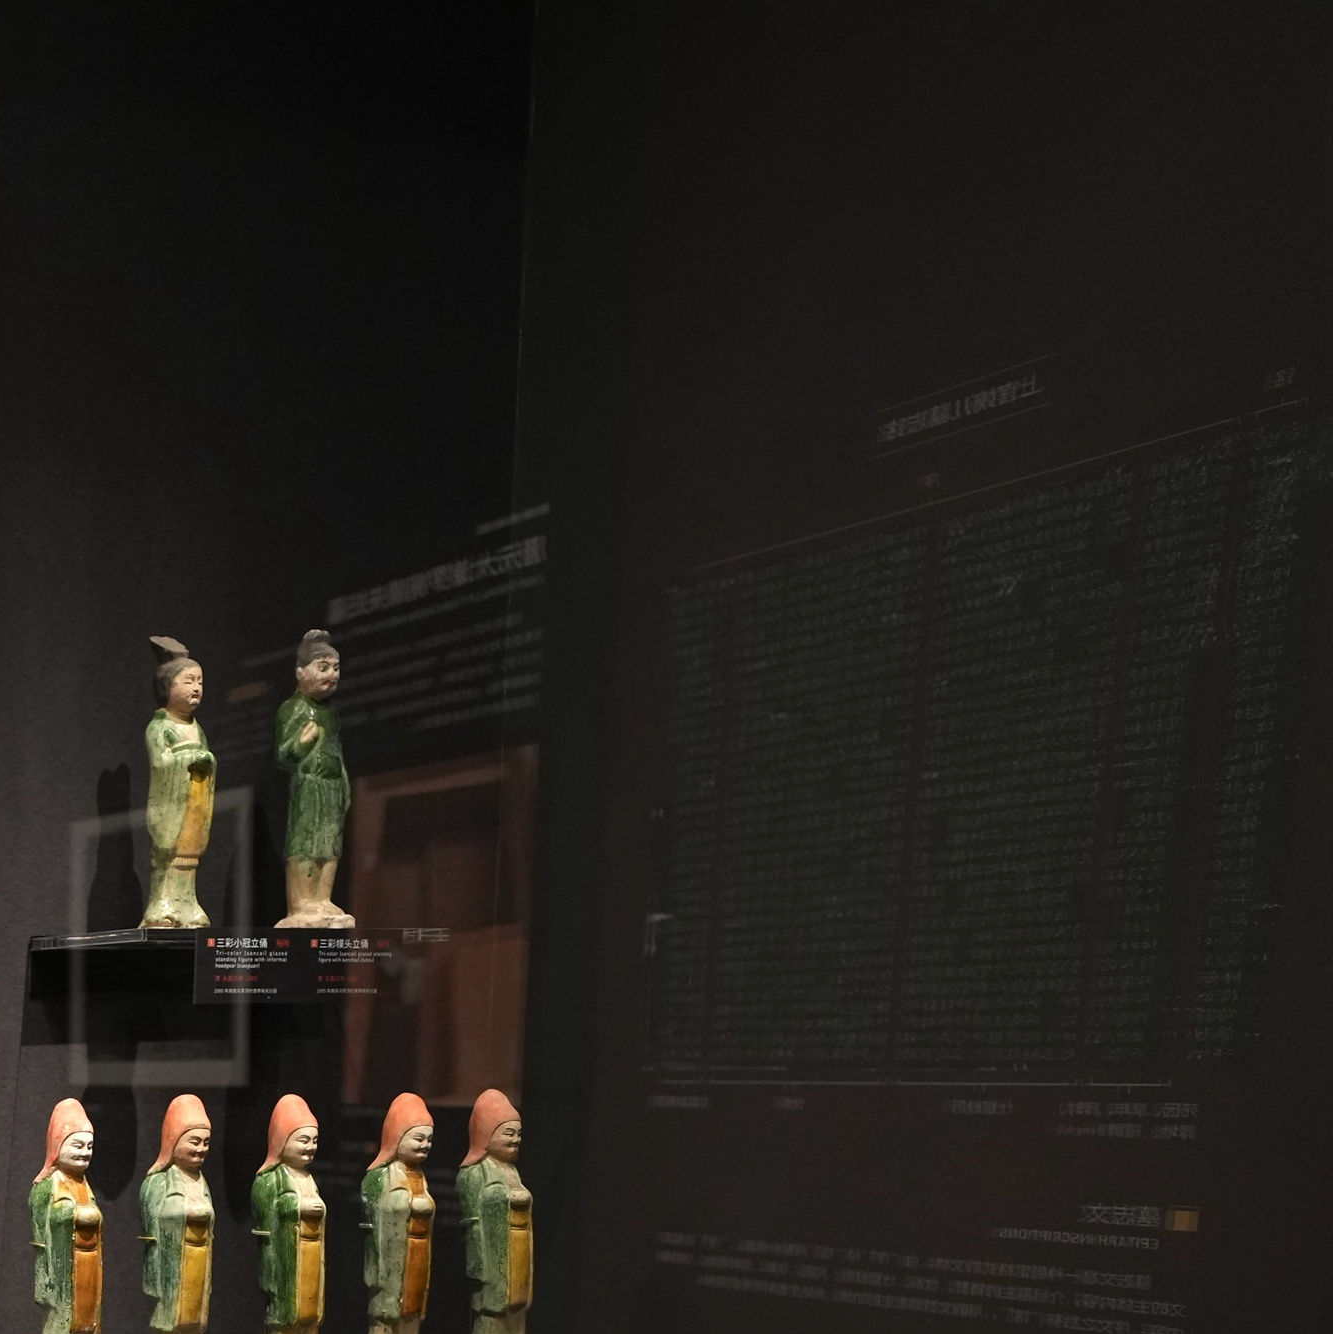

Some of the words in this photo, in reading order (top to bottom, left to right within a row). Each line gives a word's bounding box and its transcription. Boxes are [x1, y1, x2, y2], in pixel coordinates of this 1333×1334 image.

[217, 938, 268, 948] 三彩小冠立俑
